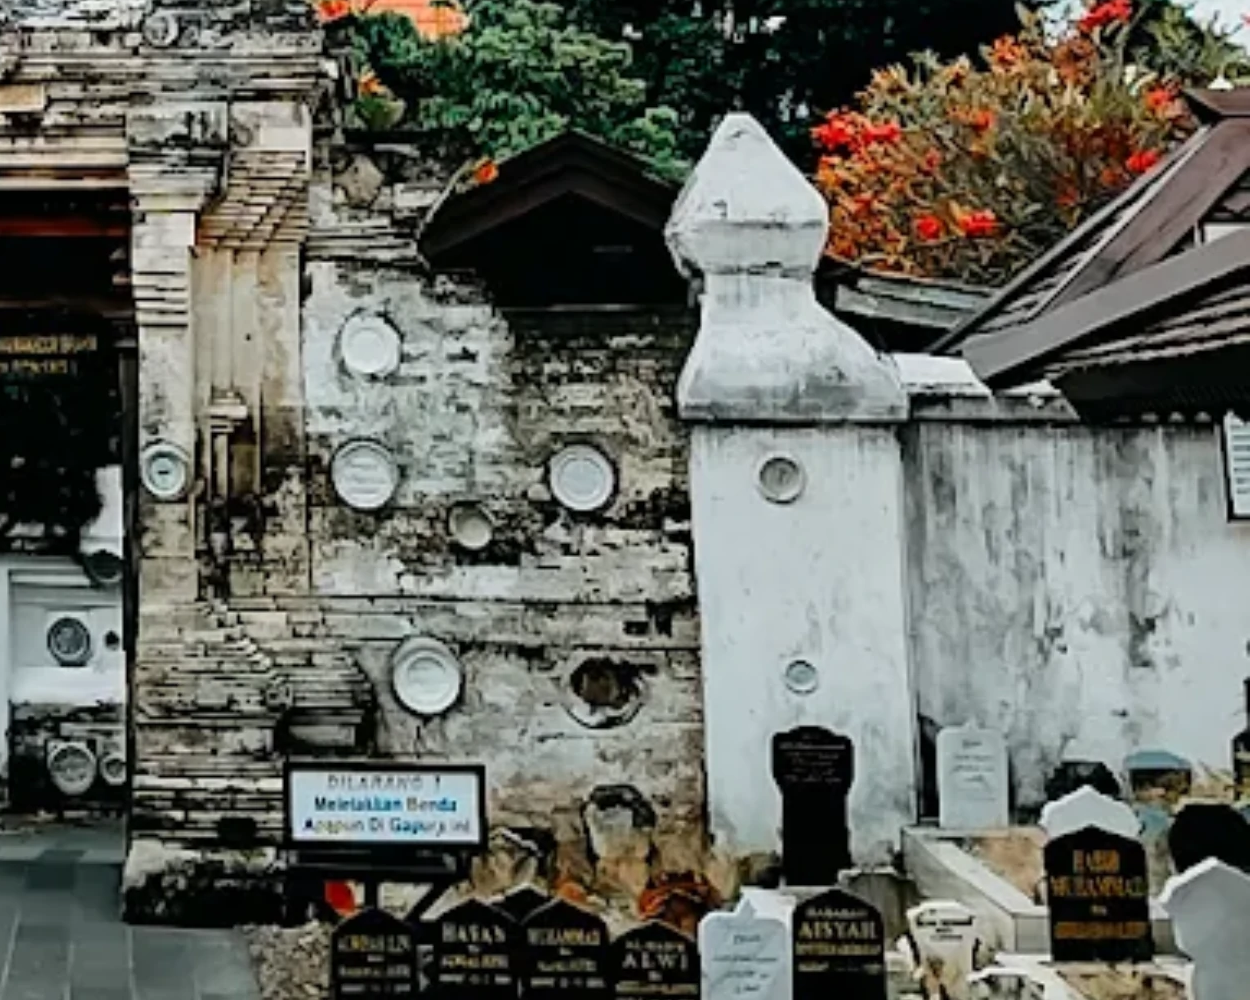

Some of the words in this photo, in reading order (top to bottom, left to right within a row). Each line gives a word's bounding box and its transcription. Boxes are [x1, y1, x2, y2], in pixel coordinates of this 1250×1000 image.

[327, 775, 424, 790] DILARANG
[314, 796, 403, 812] Meletakkan
[406, 796, 458, 812] Benda
